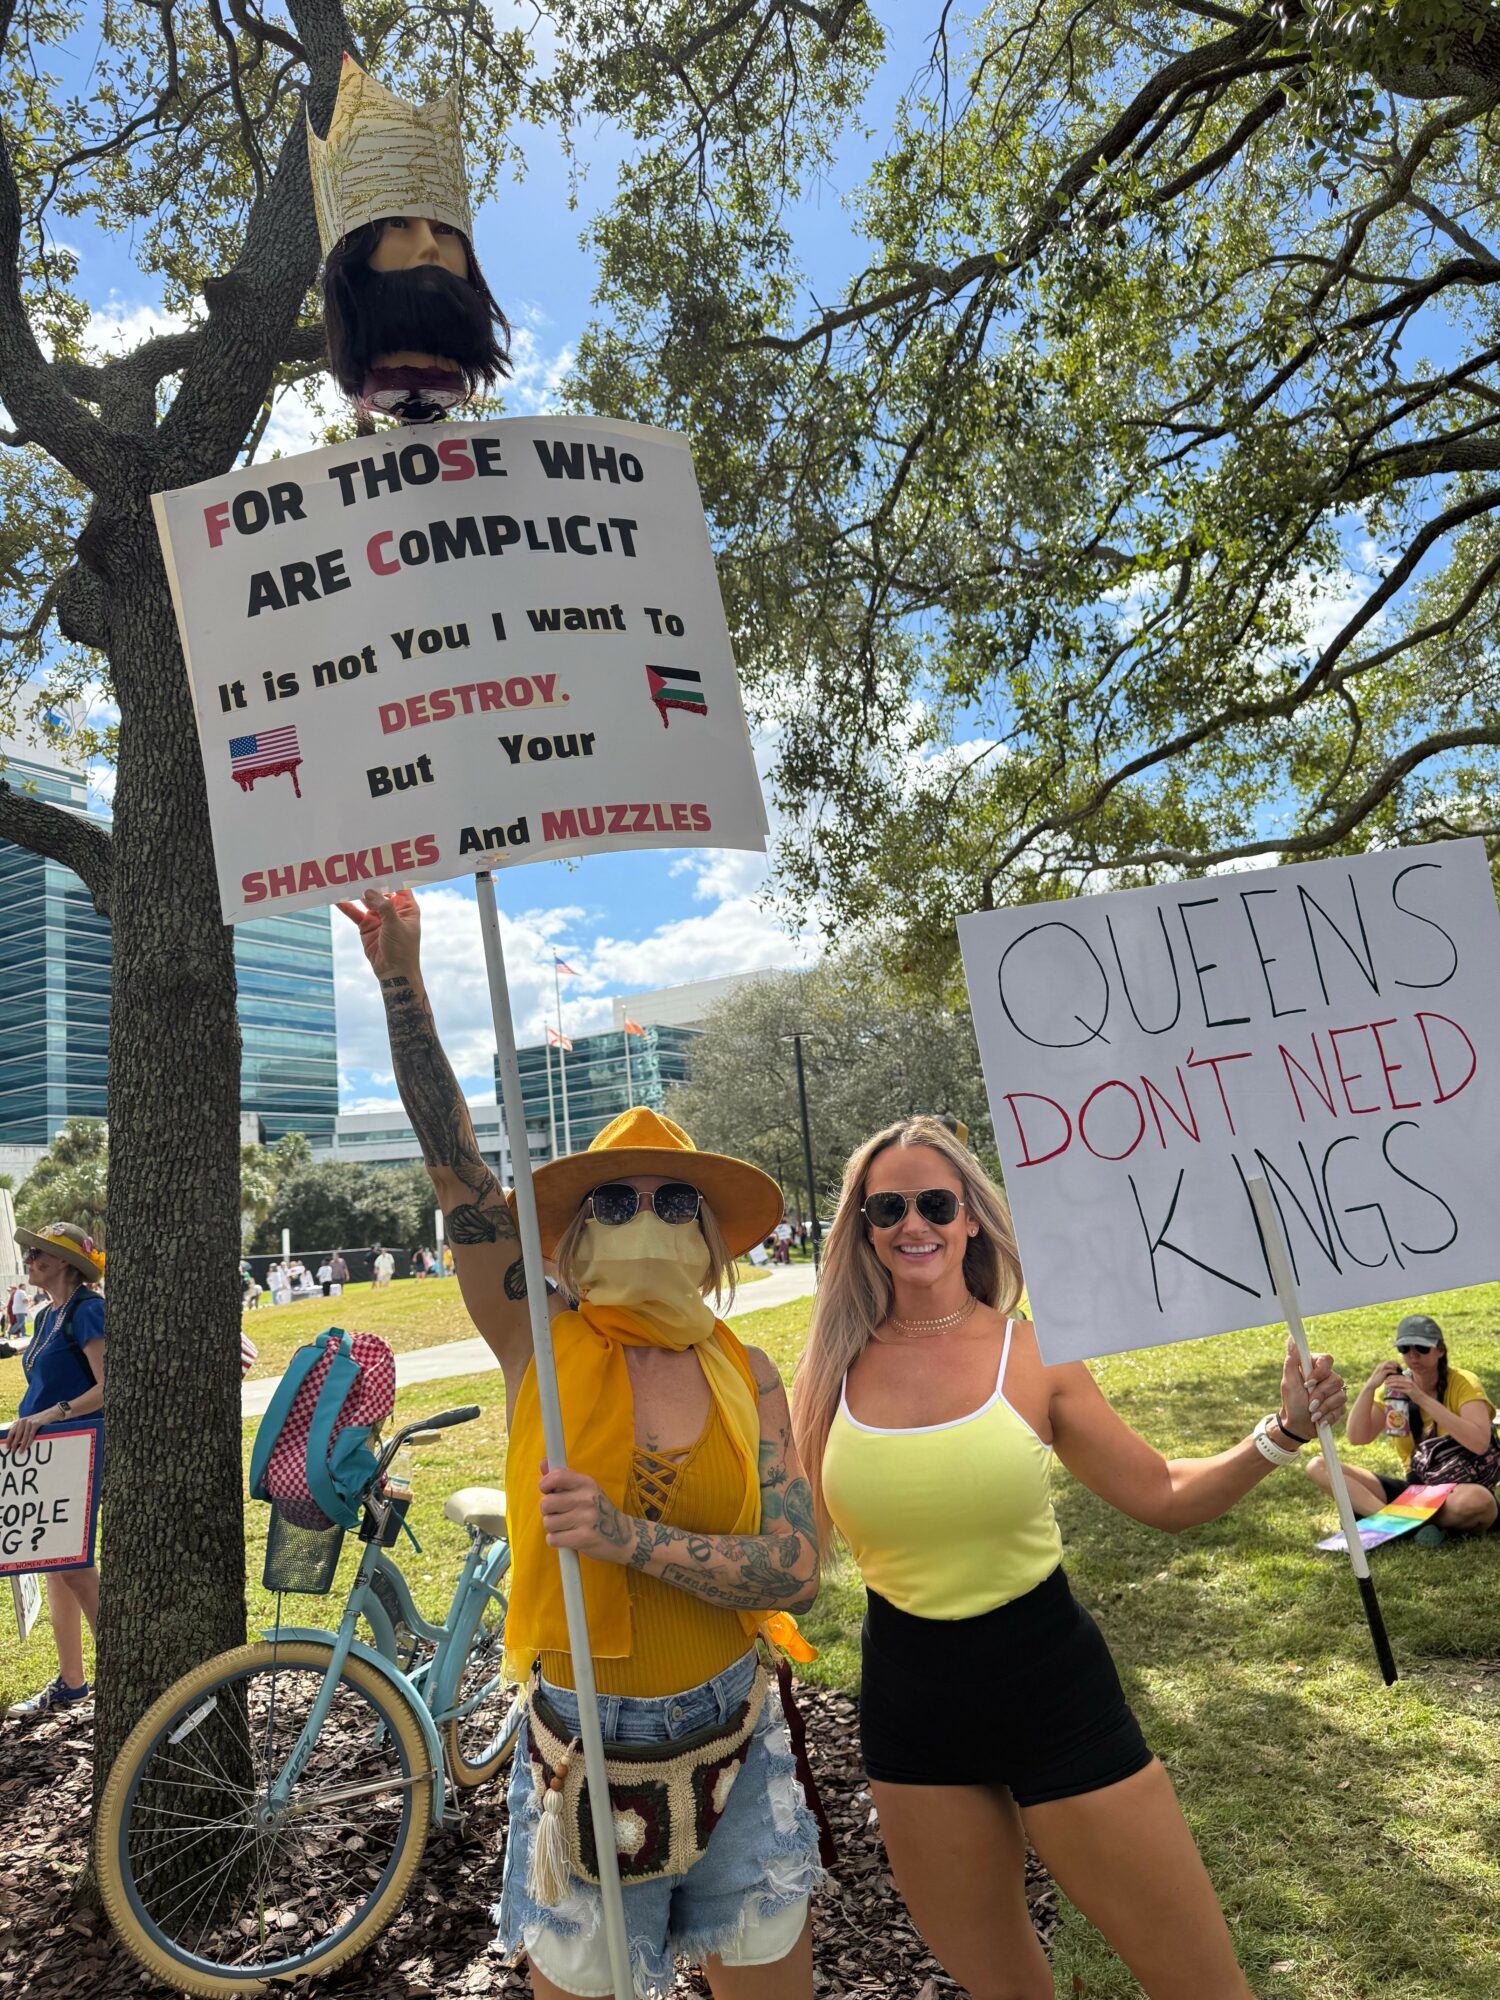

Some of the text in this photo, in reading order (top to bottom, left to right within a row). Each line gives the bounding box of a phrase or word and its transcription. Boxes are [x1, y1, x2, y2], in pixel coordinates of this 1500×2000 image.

[204, 438, 644, 548] FOR THOSE WHO
[247, 549, 352, 617] ARE
[219, 603, 685, 712] It is not You I want To
[379, 673, 570, 735] DESTROY.
[366, 732, 596, 798] But Your
[241, 804, 712, 903] SHACKLES And MUZZLES
[998, 863, 1458, 1048] QUEENS
[1003, 1012, 1477, 1168] DON'T NEED
[1128, 1121, 1458, 1313] KINGS
[0, 1468, 38, 1497] AR
[286, 1734, 310, 1786] HUFFY
